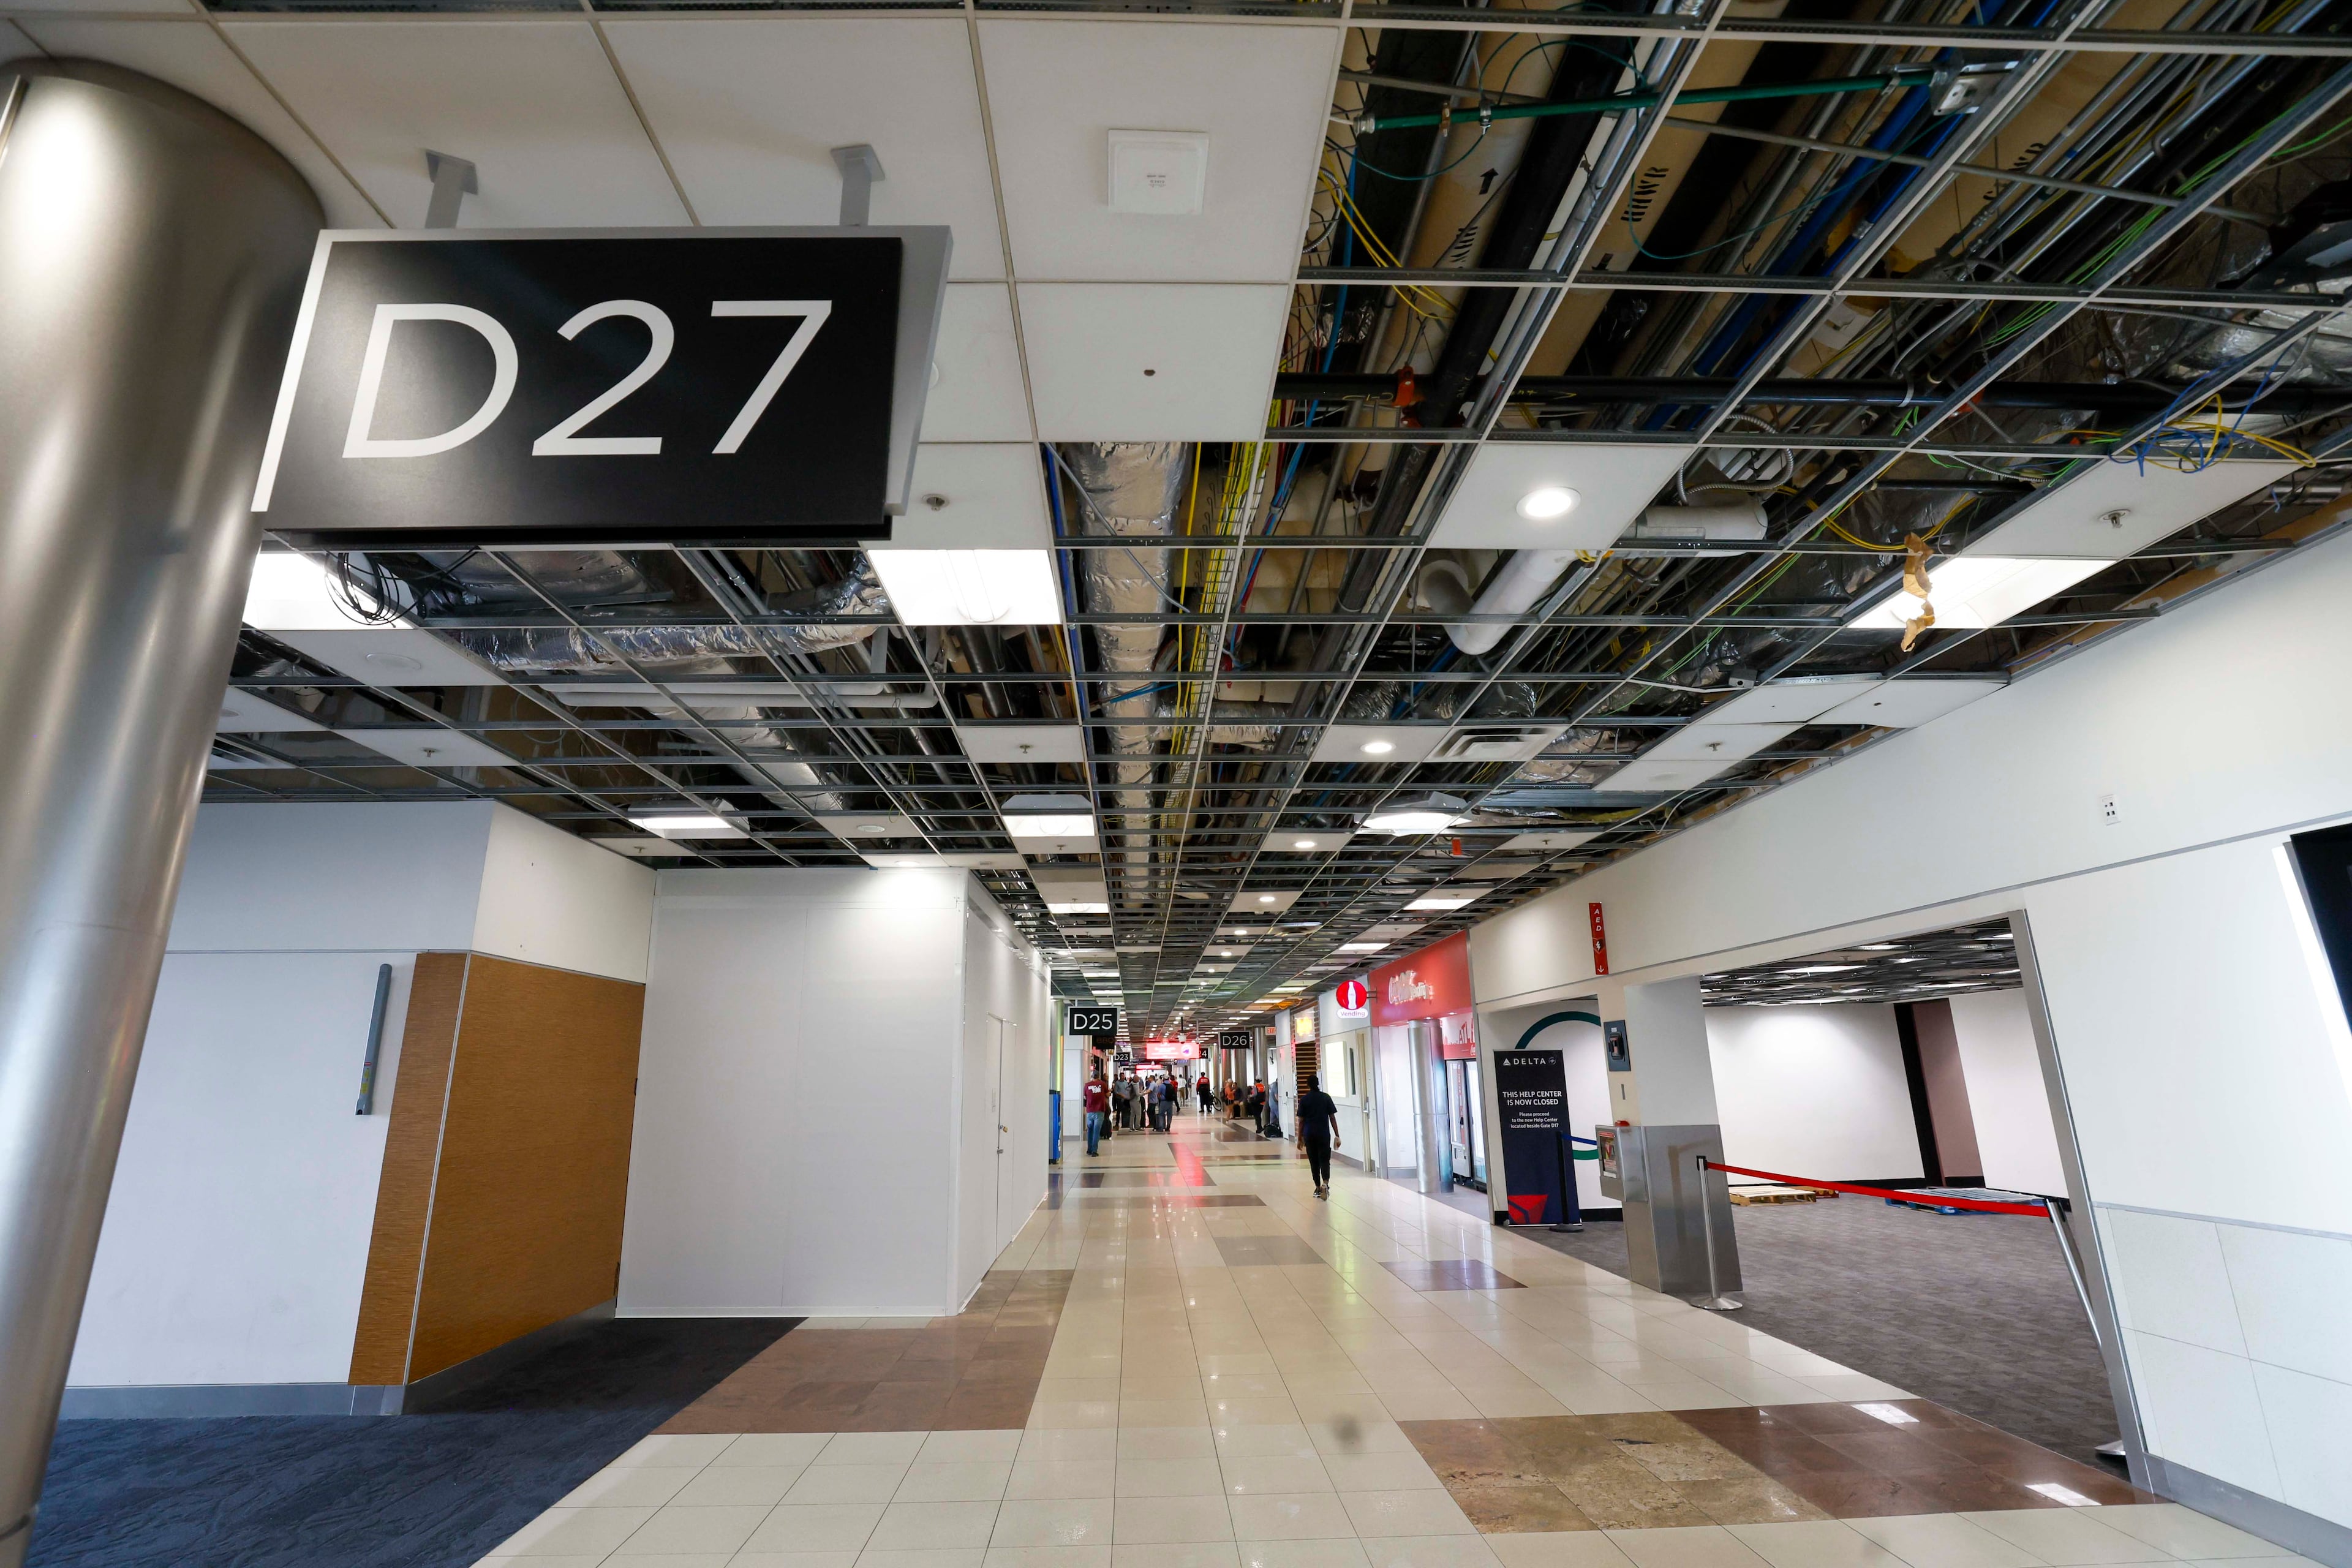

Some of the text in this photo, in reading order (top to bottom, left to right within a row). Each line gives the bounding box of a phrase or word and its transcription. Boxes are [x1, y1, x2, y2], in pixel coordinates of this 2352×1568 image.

[342, 299, 832, 459] D27
[1074, 1013, 1113, 1030] D25
[1223, 1035, 1248, 1046] D26
